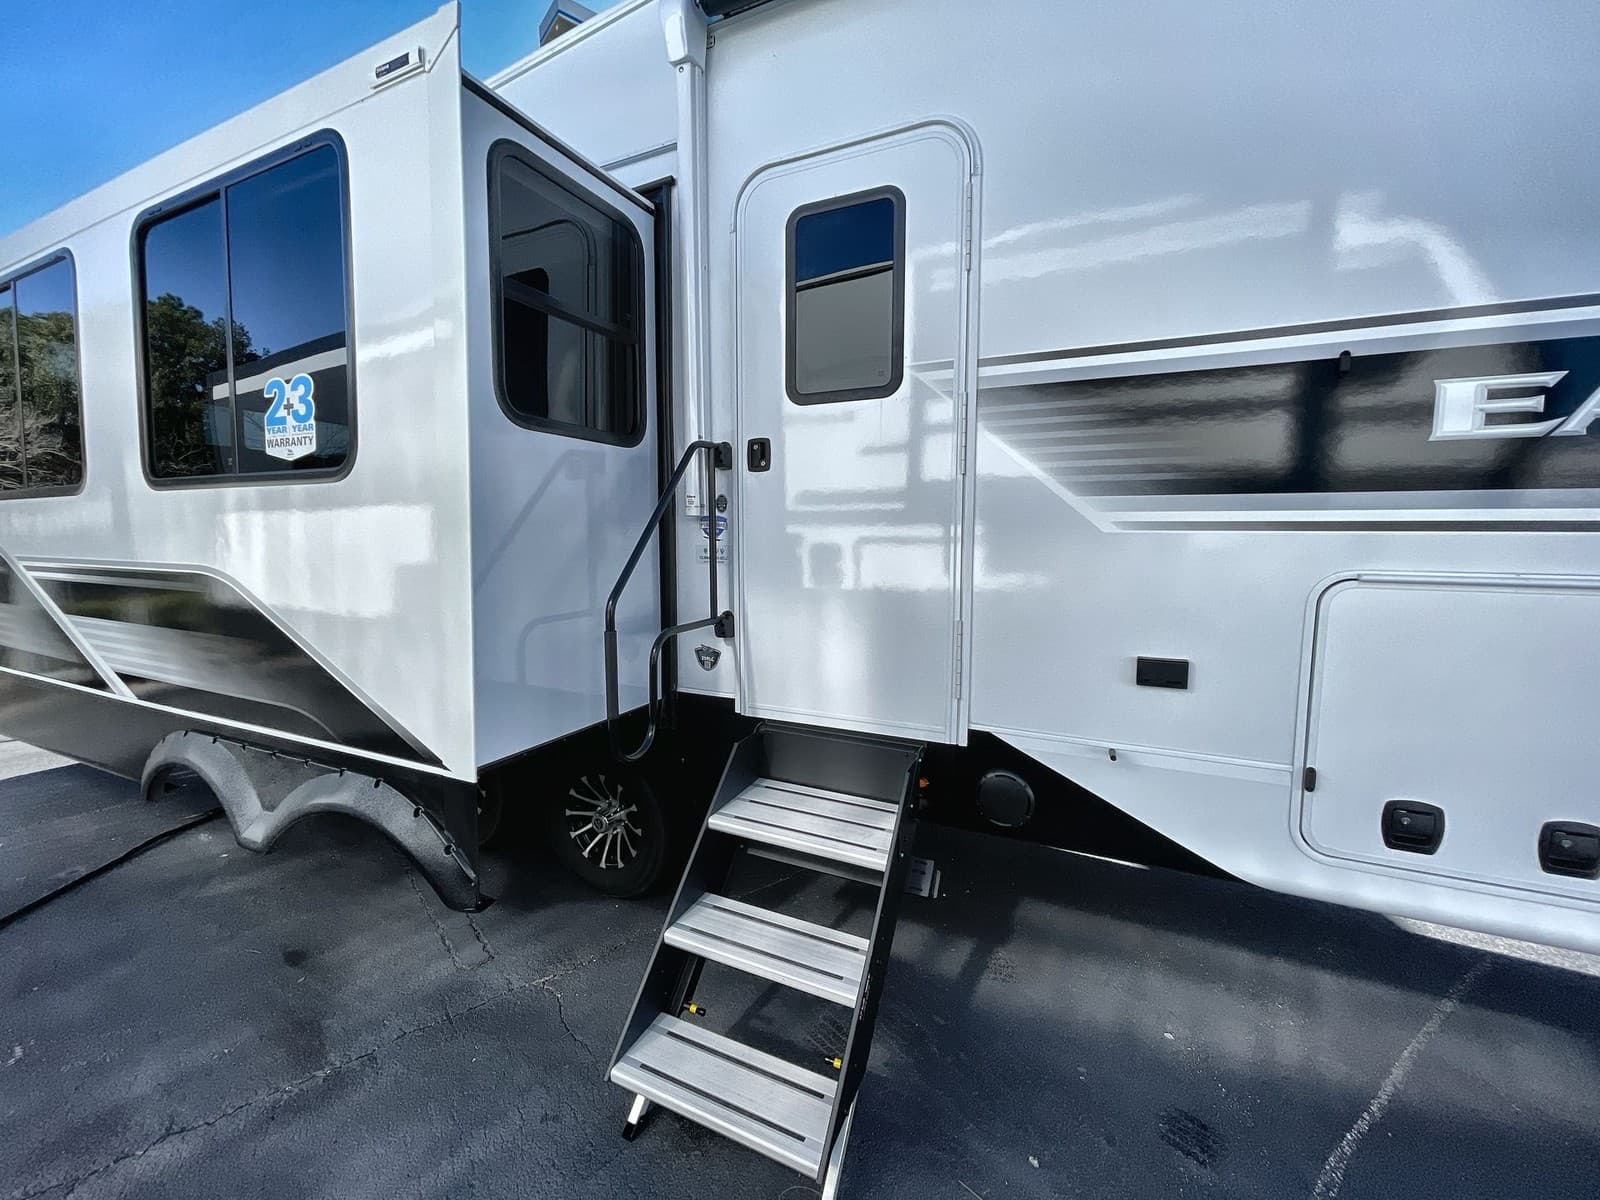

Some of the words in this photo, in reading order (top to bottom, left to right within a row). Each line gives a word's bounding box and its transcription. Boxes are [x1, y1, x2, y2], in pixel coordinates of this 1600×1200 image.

[267, 426, 287, 434] YEAR
[292, 423, 314, 432] YEAR
[267, 435, 314, 448] WARRANTY
